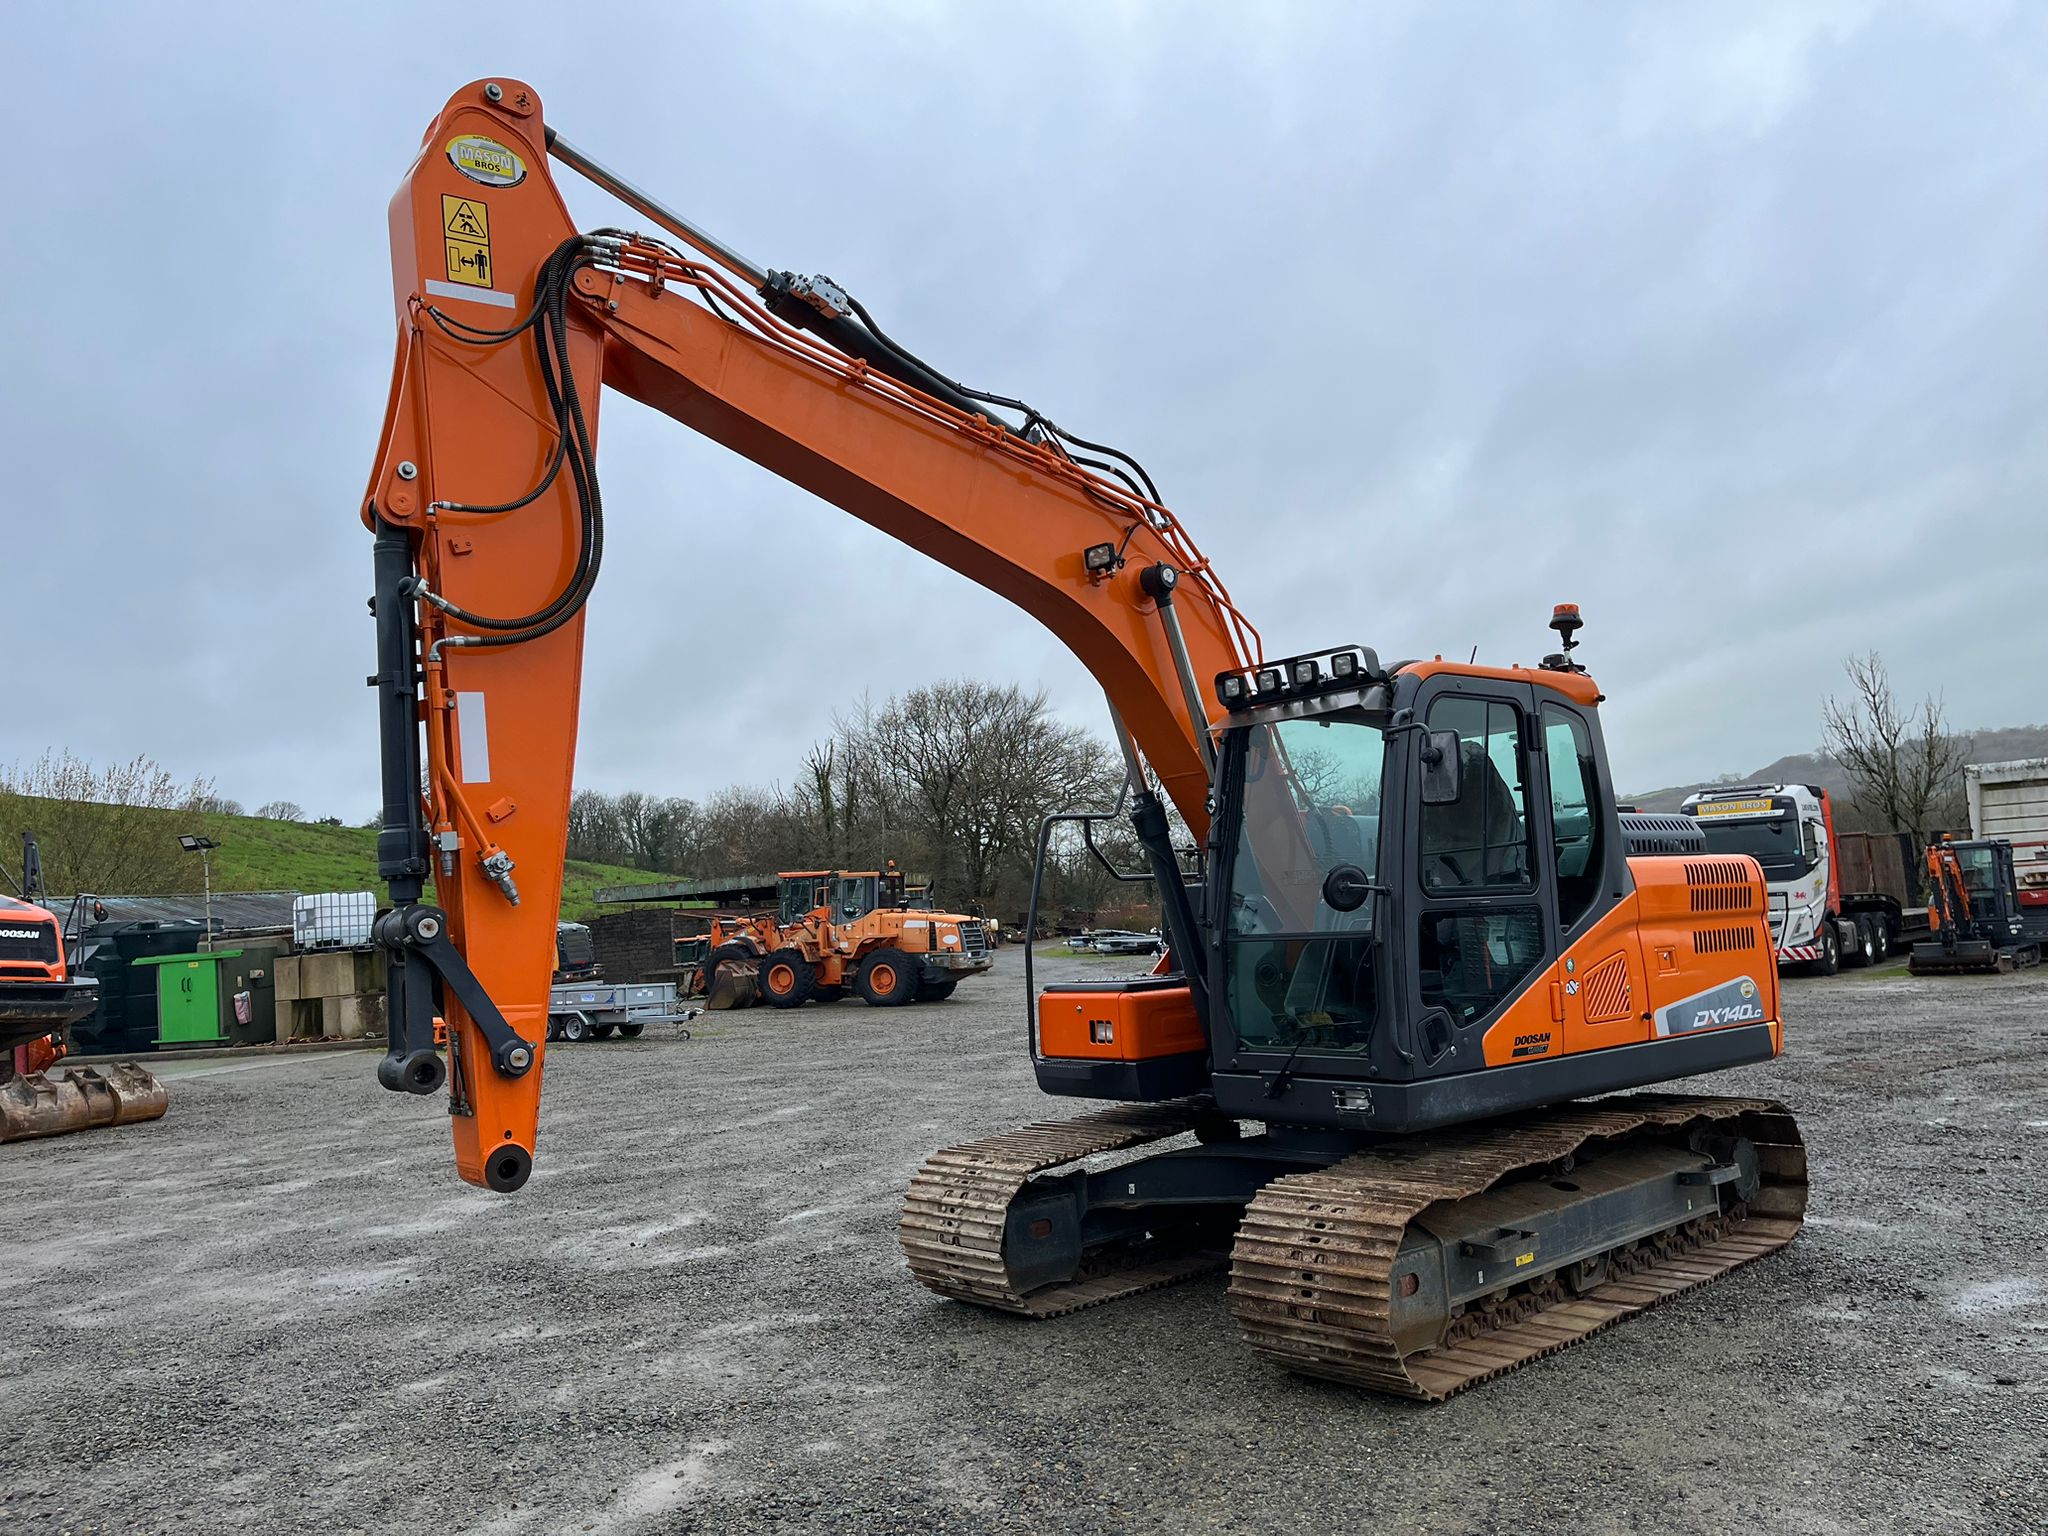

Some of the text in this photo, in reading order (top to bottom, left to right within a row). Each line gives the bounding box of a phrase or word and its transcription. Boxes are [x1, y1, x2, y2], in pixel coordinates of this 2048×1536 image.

[460, 145, 511, 169] MASON
[474, 159, 501, 173] BROS
[1701, 799, 1768, 813] MASON BROS
[1514, 1032, 1551, 1046] DOOSAN
